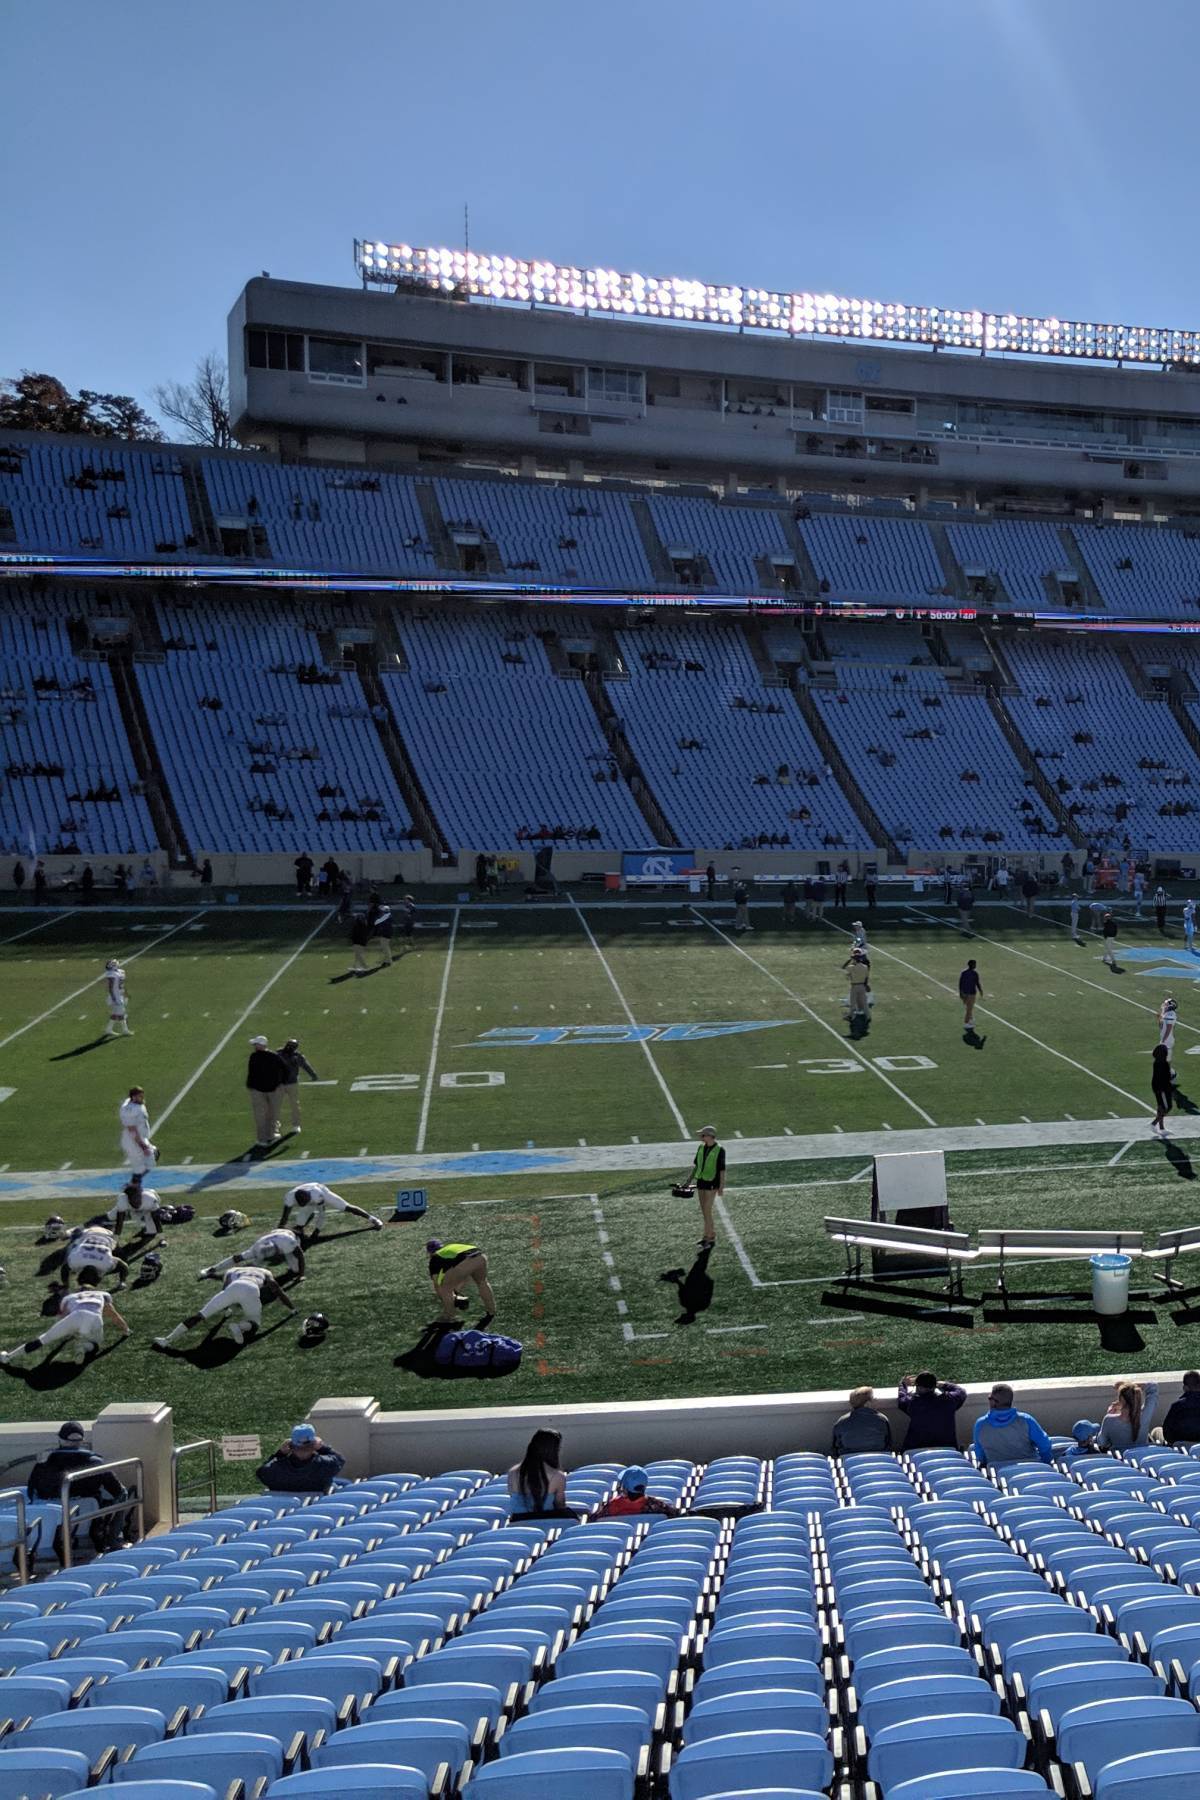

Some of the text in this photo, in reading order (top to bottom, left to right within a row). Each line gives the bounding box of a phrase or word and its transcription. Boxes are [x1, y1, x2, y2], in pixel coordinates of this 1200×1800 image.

[797, 1055, 939, 1074] 30
[349, 1071, 506, 1092] 20
[400, 1190, 424, 1208] 20
